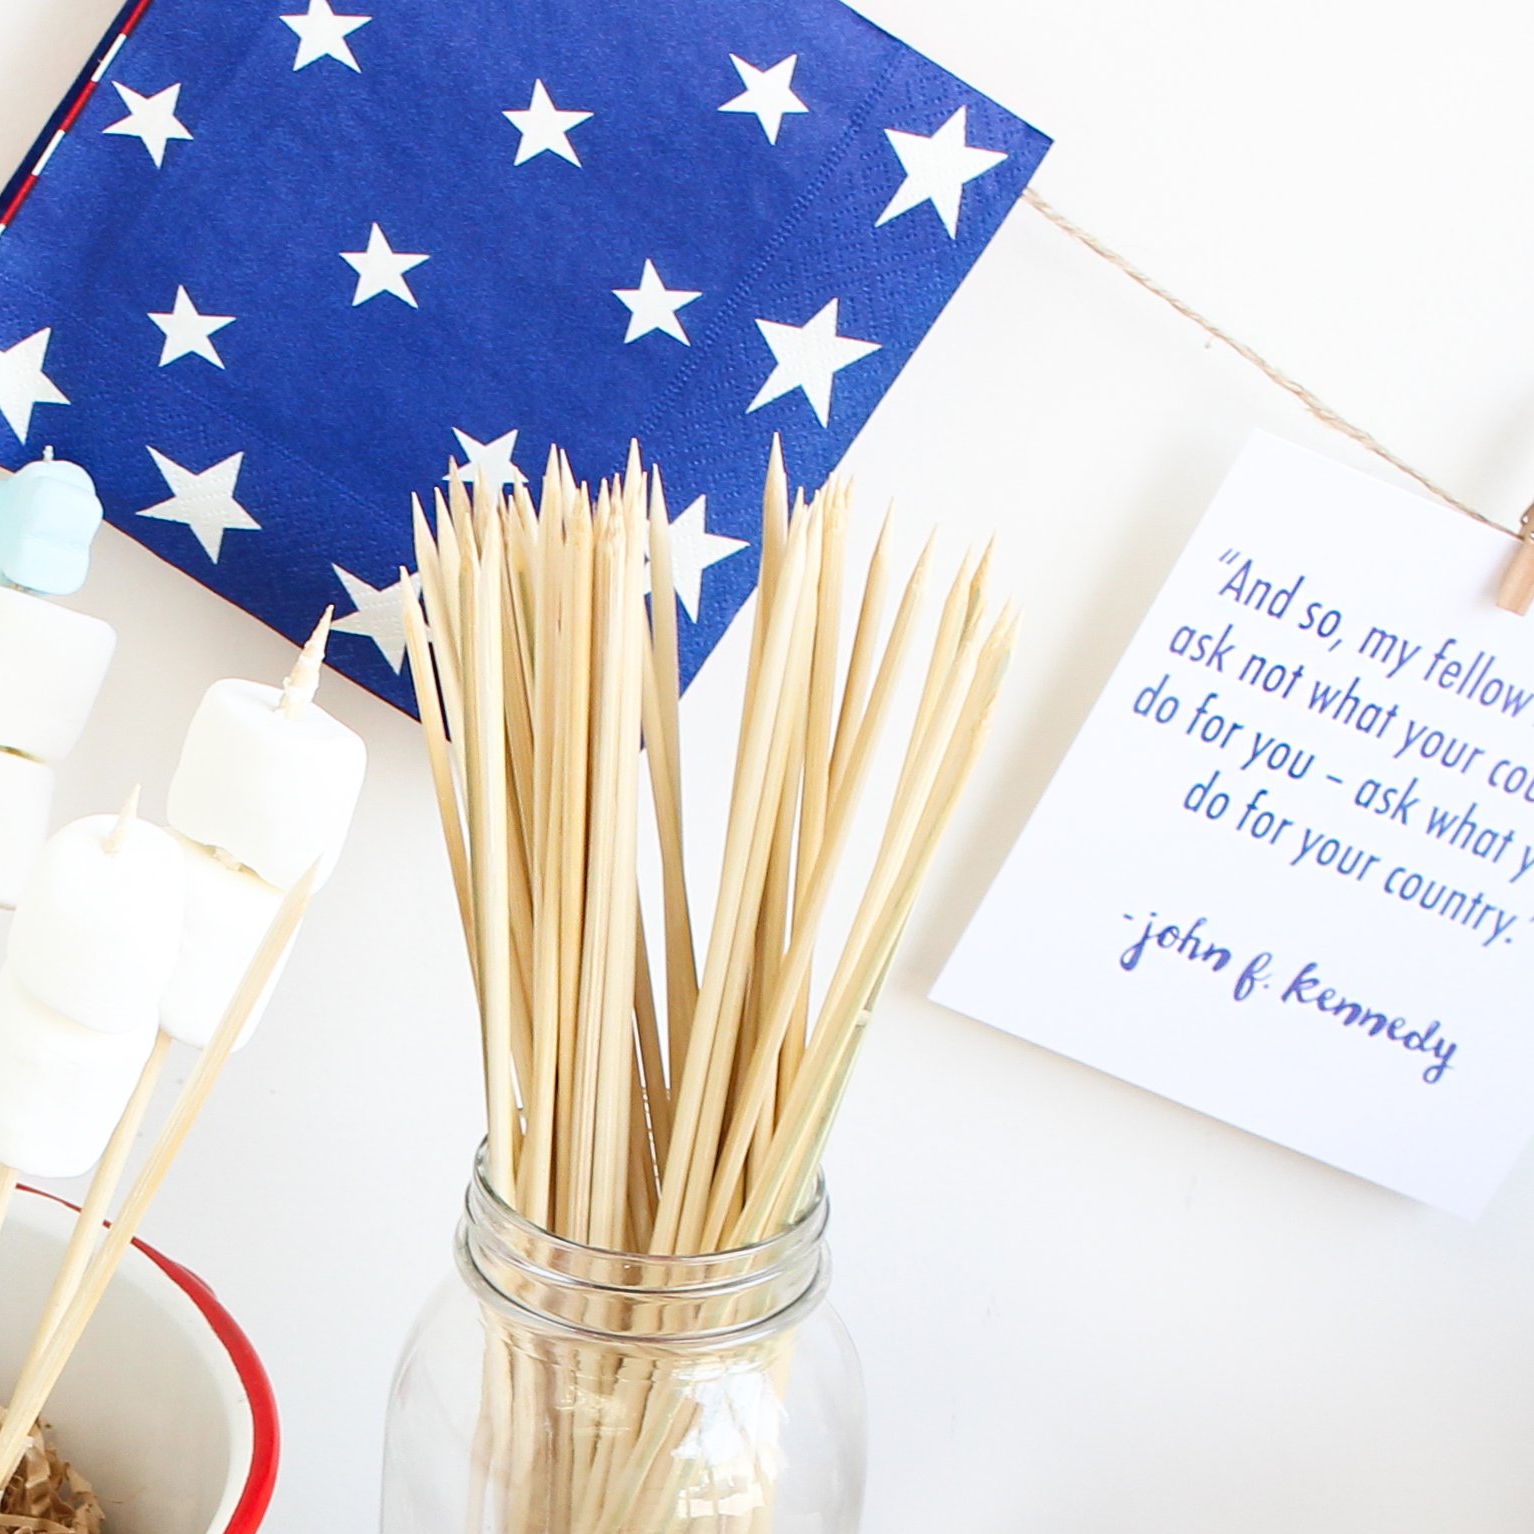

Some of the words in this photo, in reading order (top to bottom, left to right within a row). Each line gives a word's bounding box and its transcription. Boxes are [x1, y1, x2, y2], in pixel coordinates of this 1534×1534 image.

[1169, 622, 1236, 673] ask
[1237, 652, 1307, 700] not
[1307, 675, 1402, 739] what
[1393, 719, 1488, 775] your
[1217, 547, 1308, 620] “And
[1297, 600, 1344, 653] so,
[1358, 625, 1423, 680] my
[1422, 636, 1534, 718] fellow
[1132, 672, 1183, 725] do
[1185, 690, 1248, 750] for
[1239, 730, 1318, 781] you
[1353, 775, 1423, 827] ask
[1425, 800, 1518, 865] what
[1182, 768, 1233, 821] do
[1235, 787, 1297, 846] for
[1289, 826, 1384, 882] your
